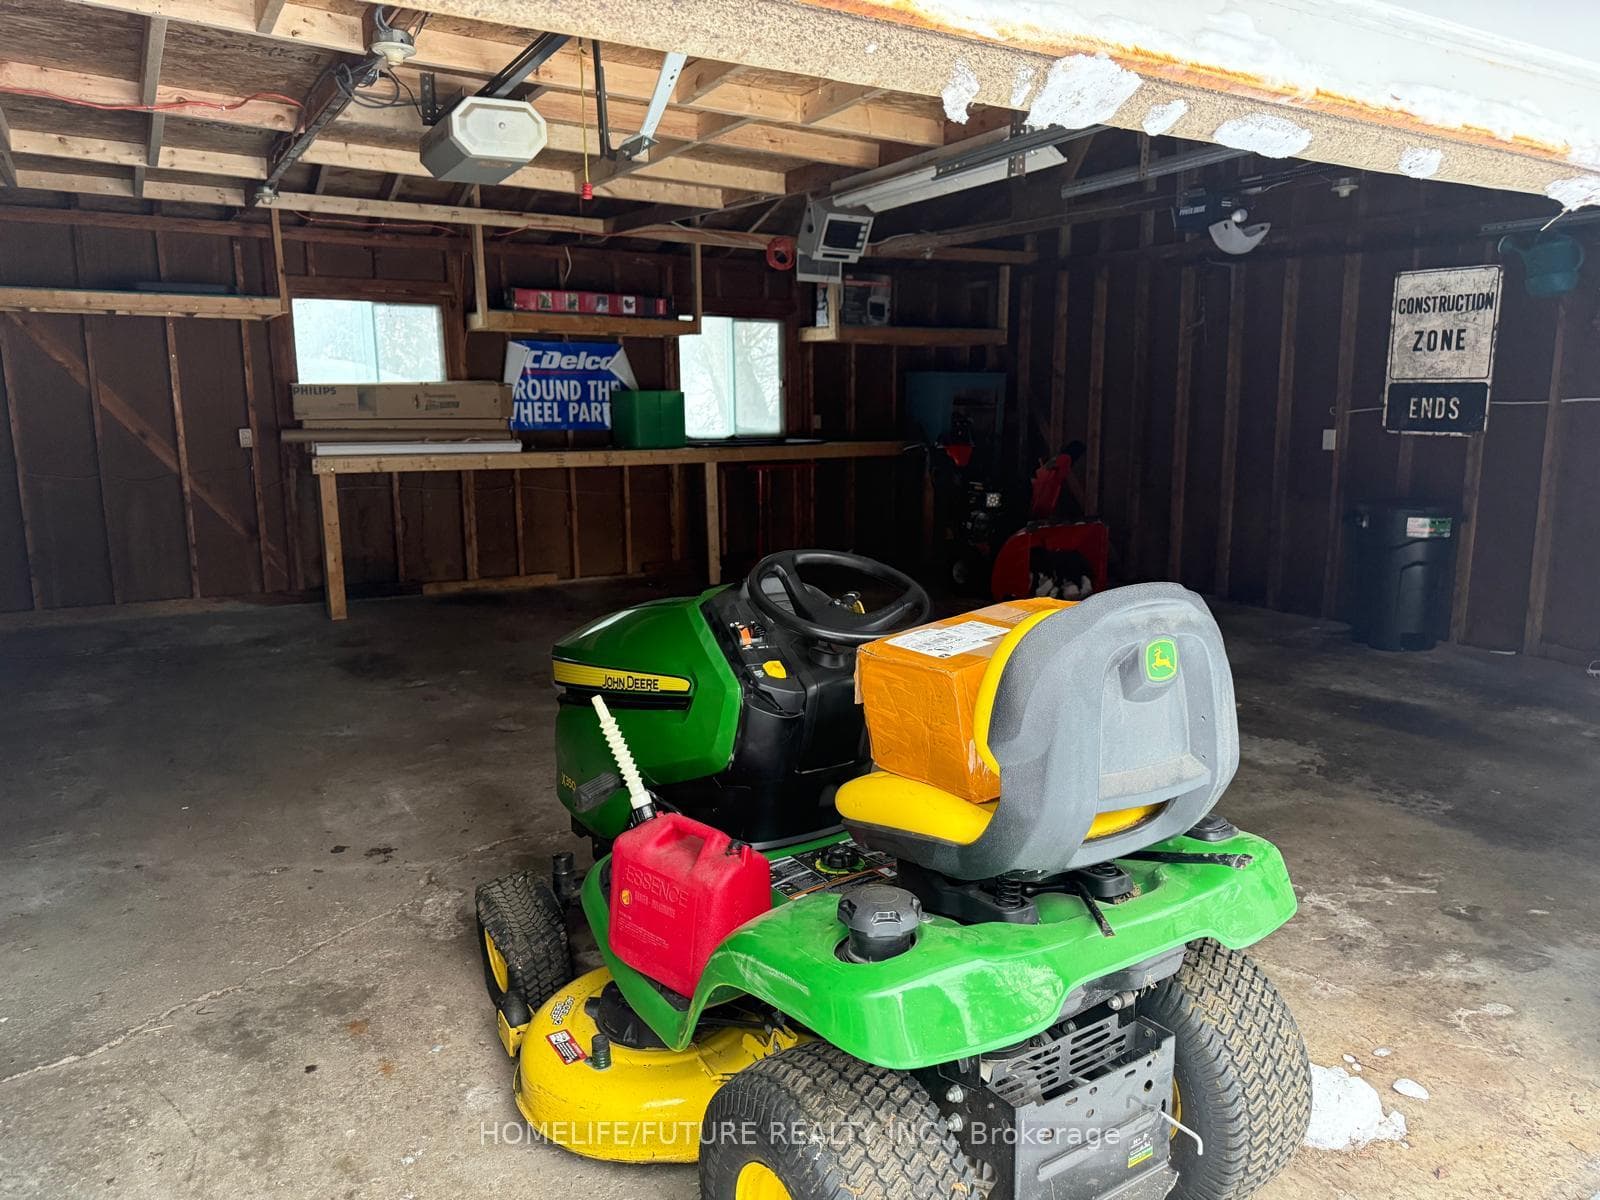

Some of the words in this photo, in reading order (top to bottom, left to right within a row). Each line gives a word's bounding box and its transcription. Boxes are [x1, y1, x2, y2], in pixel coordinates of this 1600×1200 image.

[1398, 292, 1494, 315] CONSTRUCTION
[1412, 329, 1467, 352] ZONE
[292, 385, 337, 396] PHILIPS
[515, 379, 582, 401] ROUND
[1408, 397, 1461, 420] ENDS
[602, 674, 626, 690] JOHN
[626, 675, 660, 691] DEERE
[624, 864, 689, 908] ESSENCE
